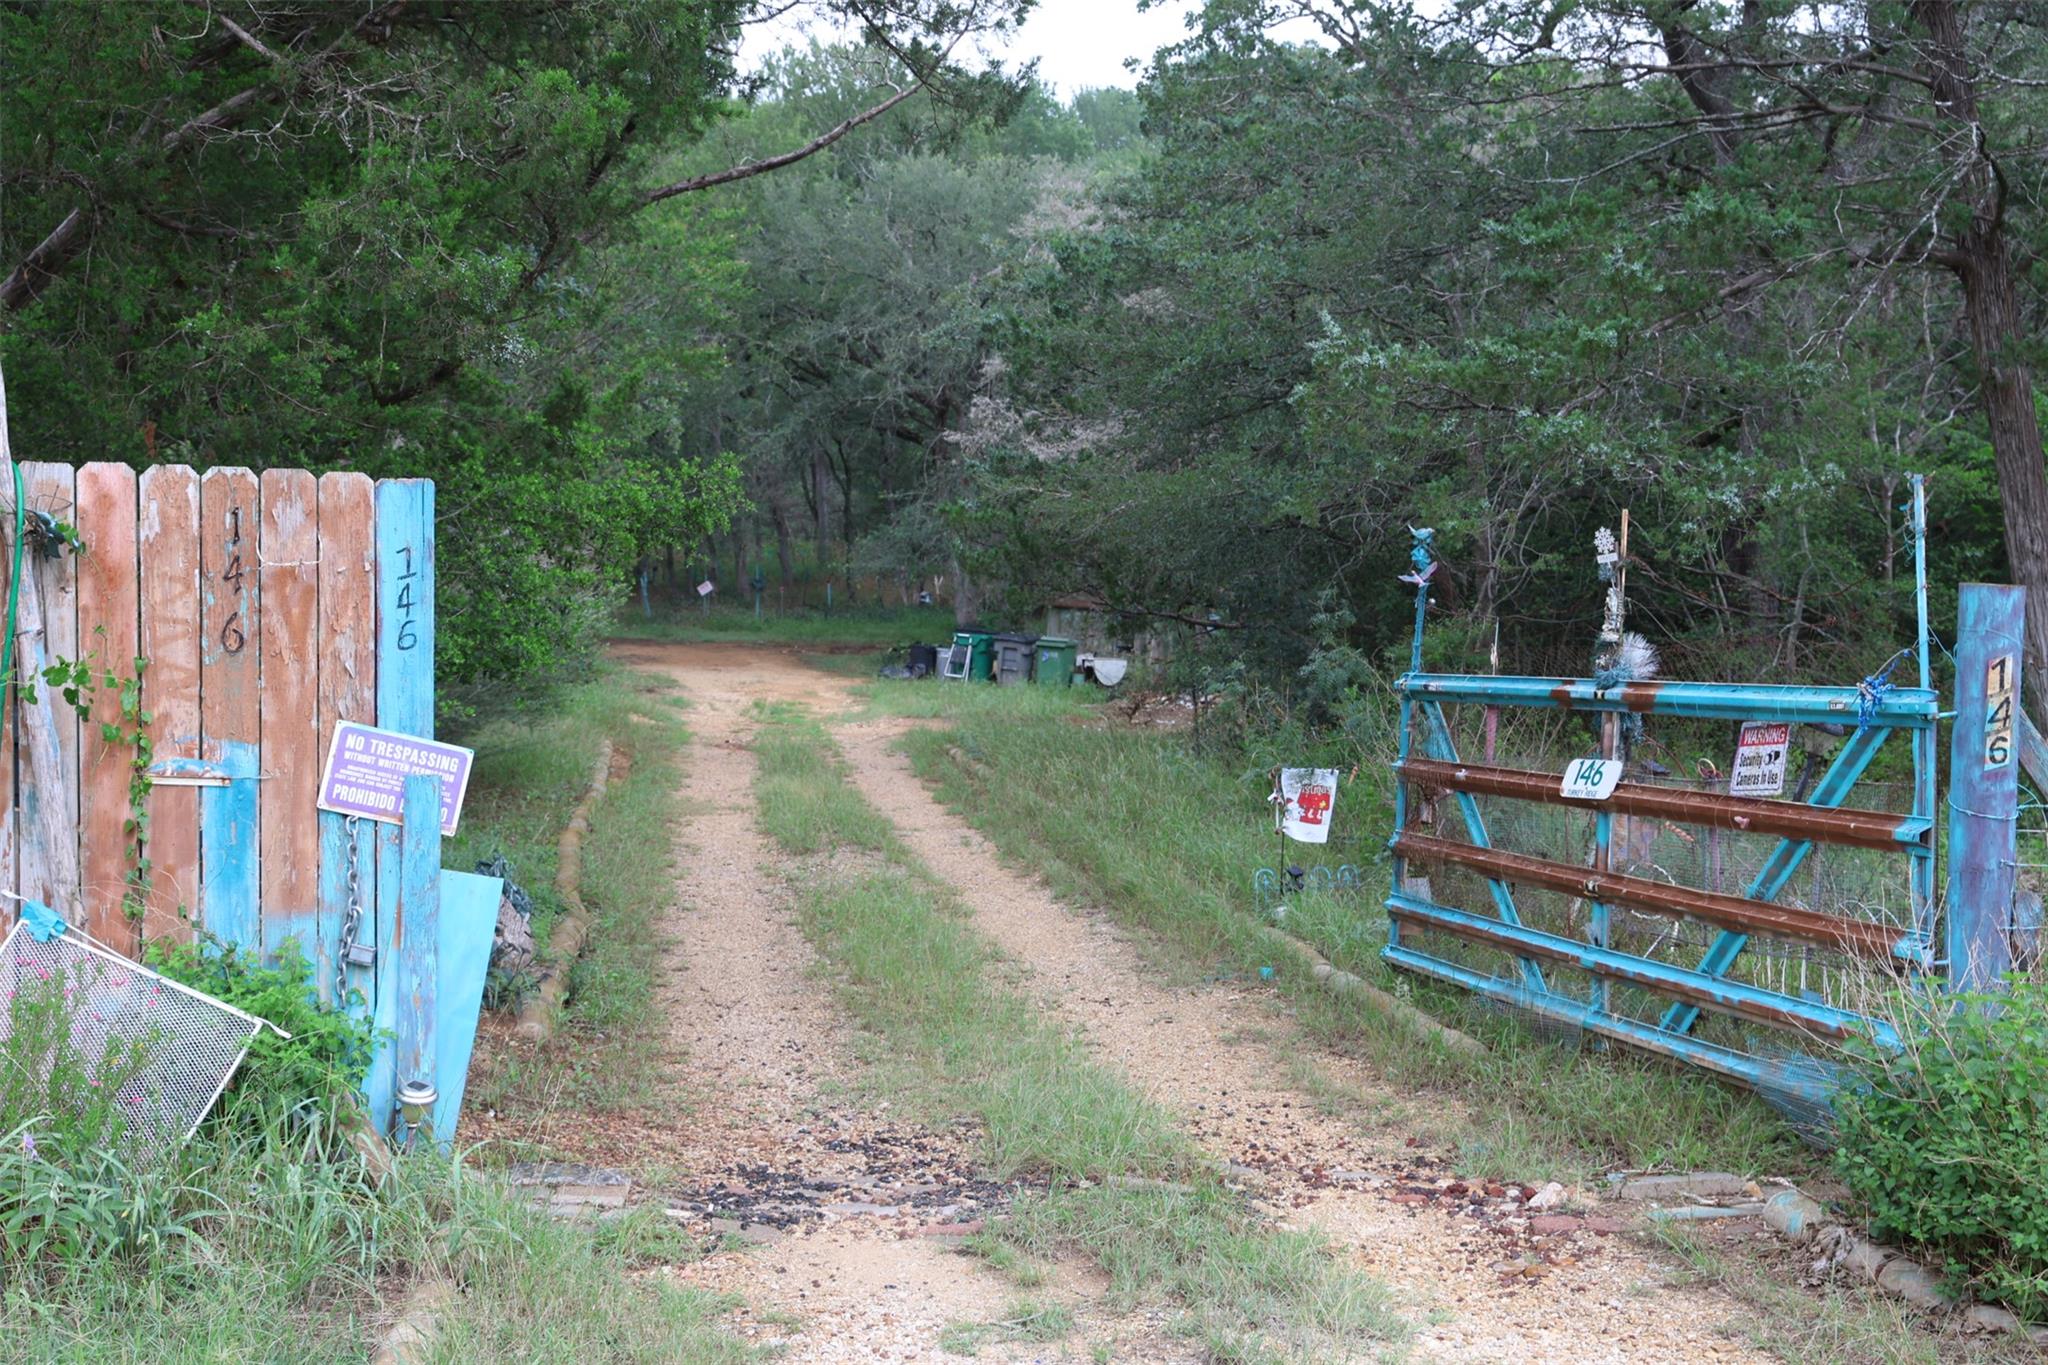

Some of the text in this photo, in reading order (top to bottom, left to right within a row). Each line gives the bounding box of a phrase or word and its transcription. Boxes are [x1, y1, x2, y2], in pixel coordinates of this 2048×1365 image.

[222, 507, 244, 656] 146
[396, 547, 417, 651] 146
[1988, 657, 2011, 764] 146
[1743, 727, 1786, 745] WARNING
[344, 751, 375, 765] WITHOUT
[378, 758, 410, 773] WRITTEN
[345, 733, 365, 751] NO
[369, 739, 459, 773] TRESPASSING
[1739, 752, 1763, 769] Security
[1573, 760, 1606, 786] 146
[1736, 771, 1760, 786] Cameras
[1767, 770, 1778, 785] Use
[332, 784, 396, 811] PROHIBIDO
